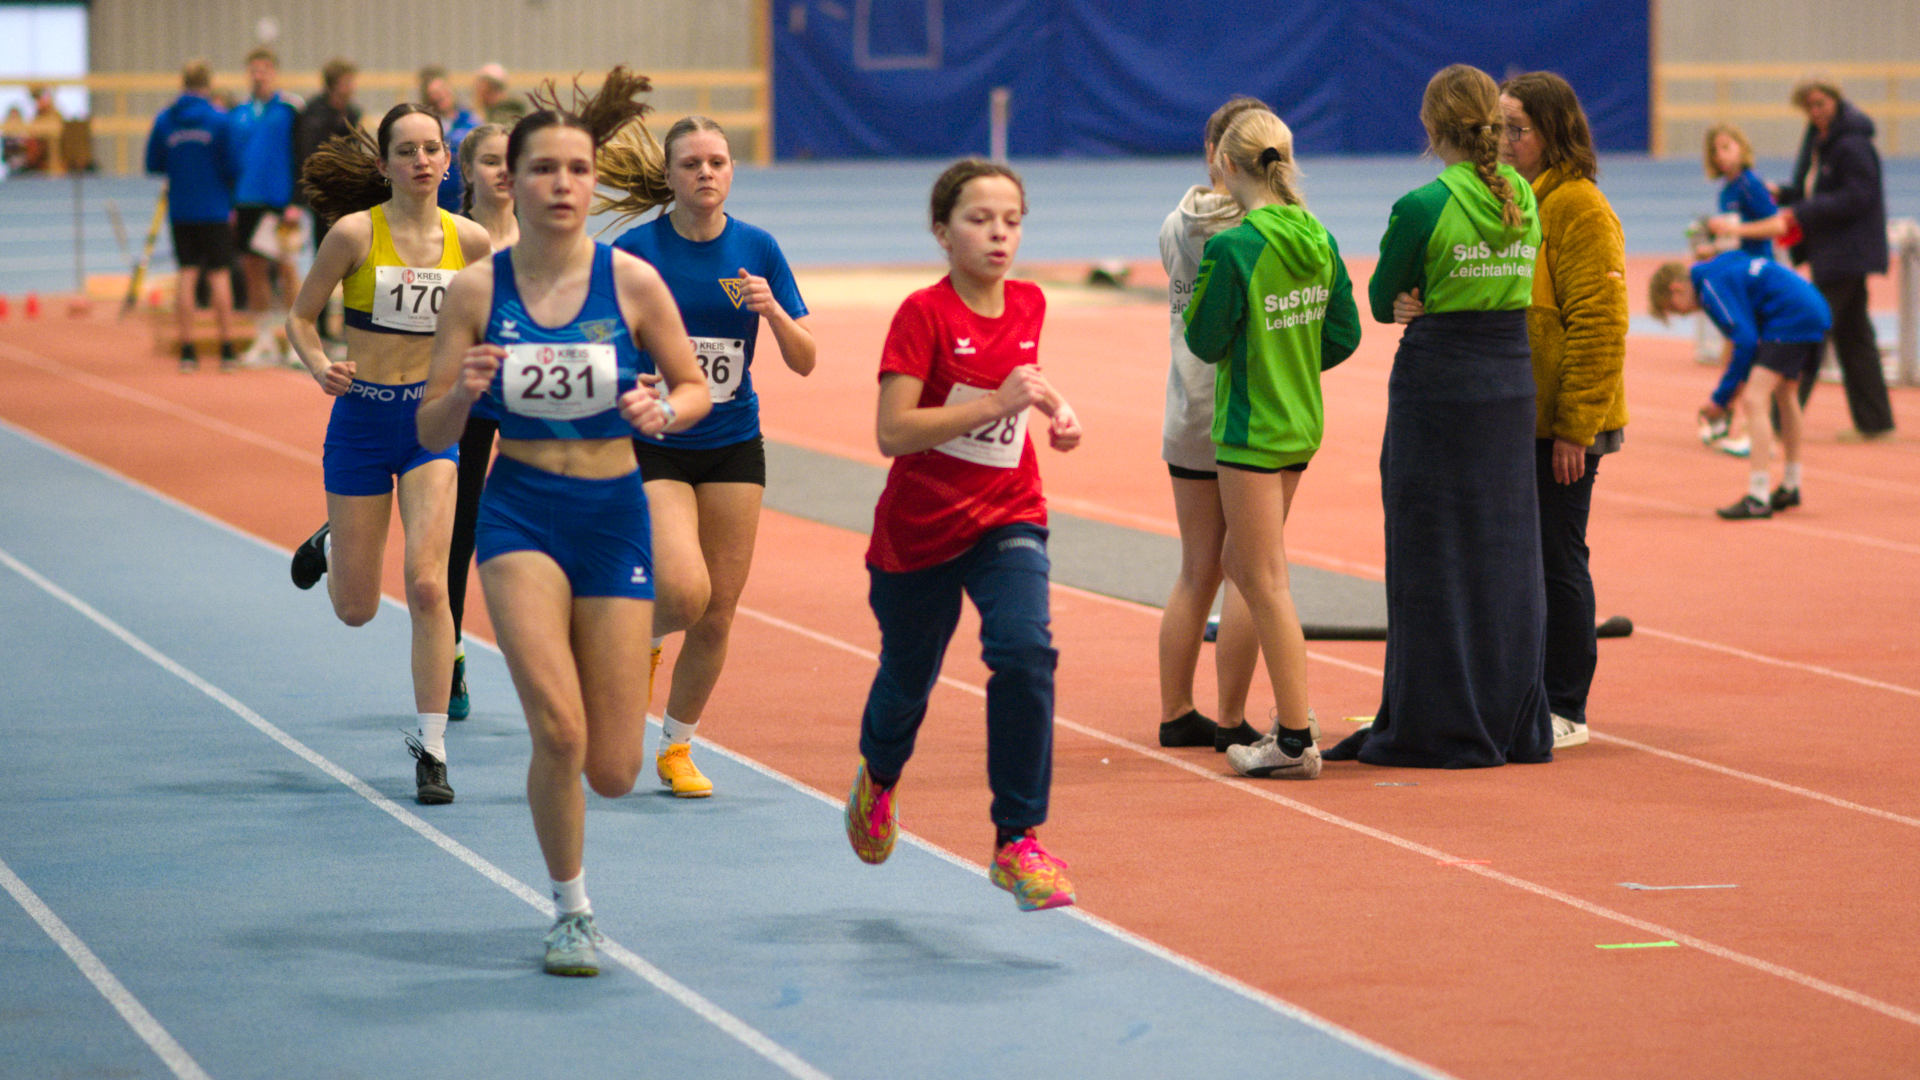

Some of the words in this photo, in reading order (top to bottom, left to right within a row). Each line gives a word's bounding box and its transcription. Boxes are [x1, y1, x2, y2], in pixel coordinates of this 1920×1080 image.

[1452, 241, 1491, 262] SuS
[416, 272, 442, 281] KREIS
[390, 283, 446, 315] 170
[1264, 290, 1301, 313] SuS
[699, 342, 726, 351] KREIS
[348, 382, 396, 402] PRO
[521, 364, 595, 400] 231
